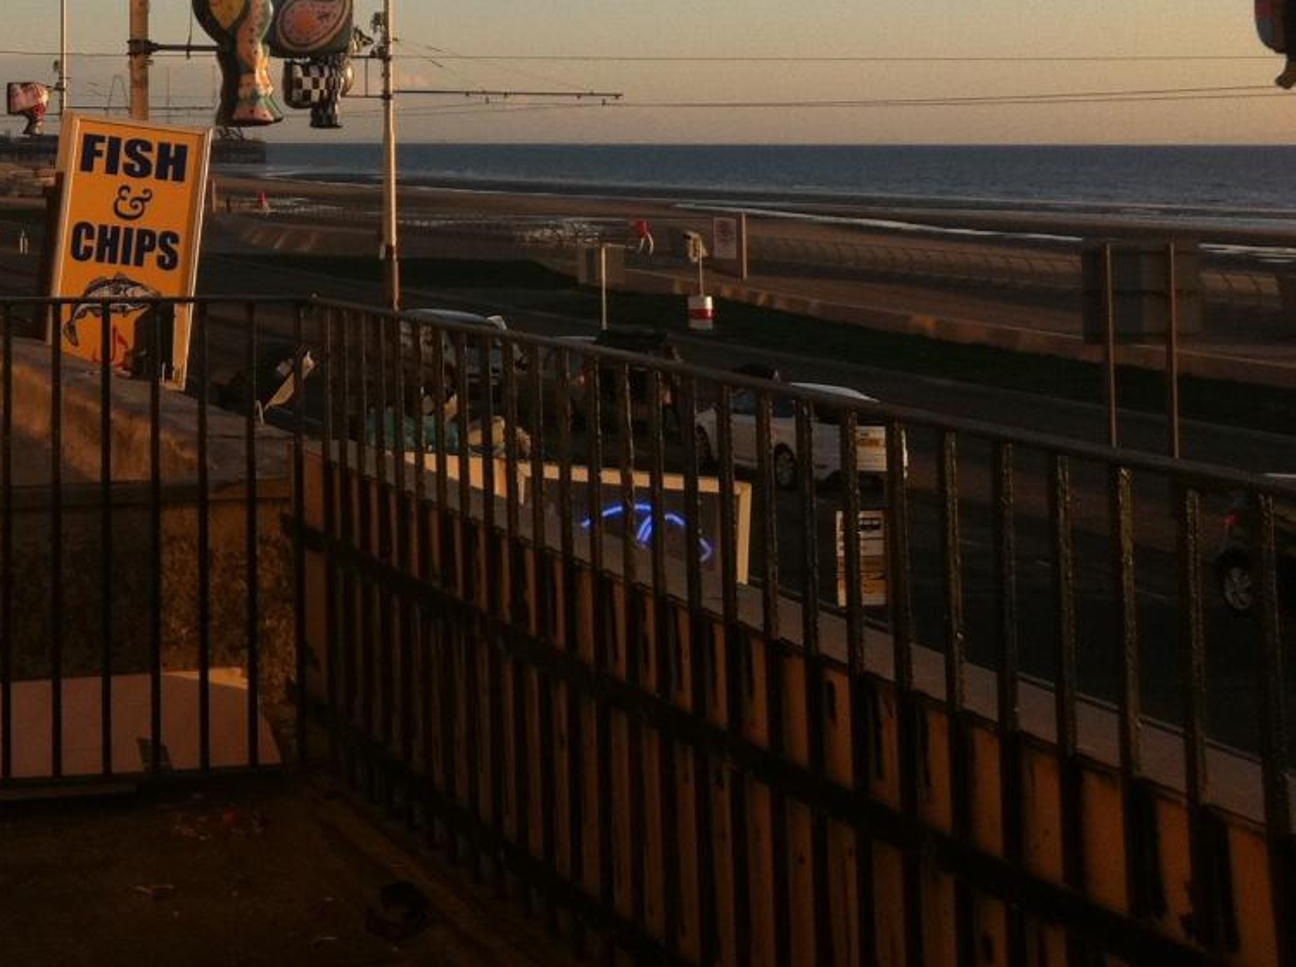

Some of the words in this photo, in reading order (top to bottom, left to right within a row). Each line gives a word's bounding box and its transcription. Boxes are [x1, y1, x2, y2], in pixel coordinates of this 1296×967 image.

[80, 134, 187, 182] FISH
[113, 185, 152, 220] &
[70, 221, 179, 271] CHIPS
